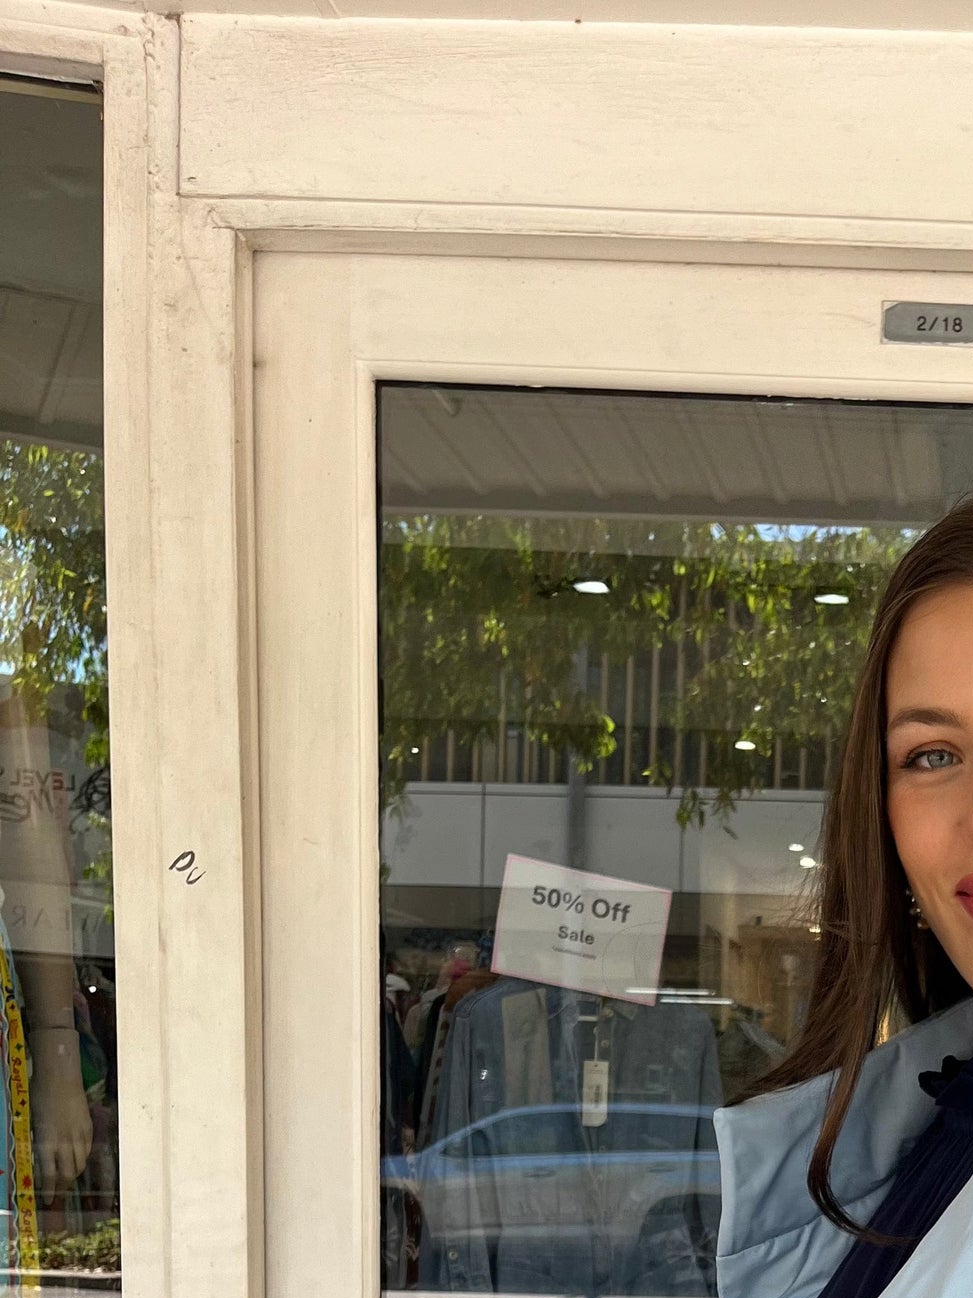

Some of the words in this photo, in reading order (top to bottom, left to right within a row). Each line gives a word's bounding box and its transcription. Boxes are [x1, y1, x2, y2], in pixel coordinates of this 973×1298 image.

[916, 315, 963, 333] 2/18
[531, 885, 584, 914] 50%
[591, 898, 631, 923] Off
[557, 925, 595, 945] Sale
